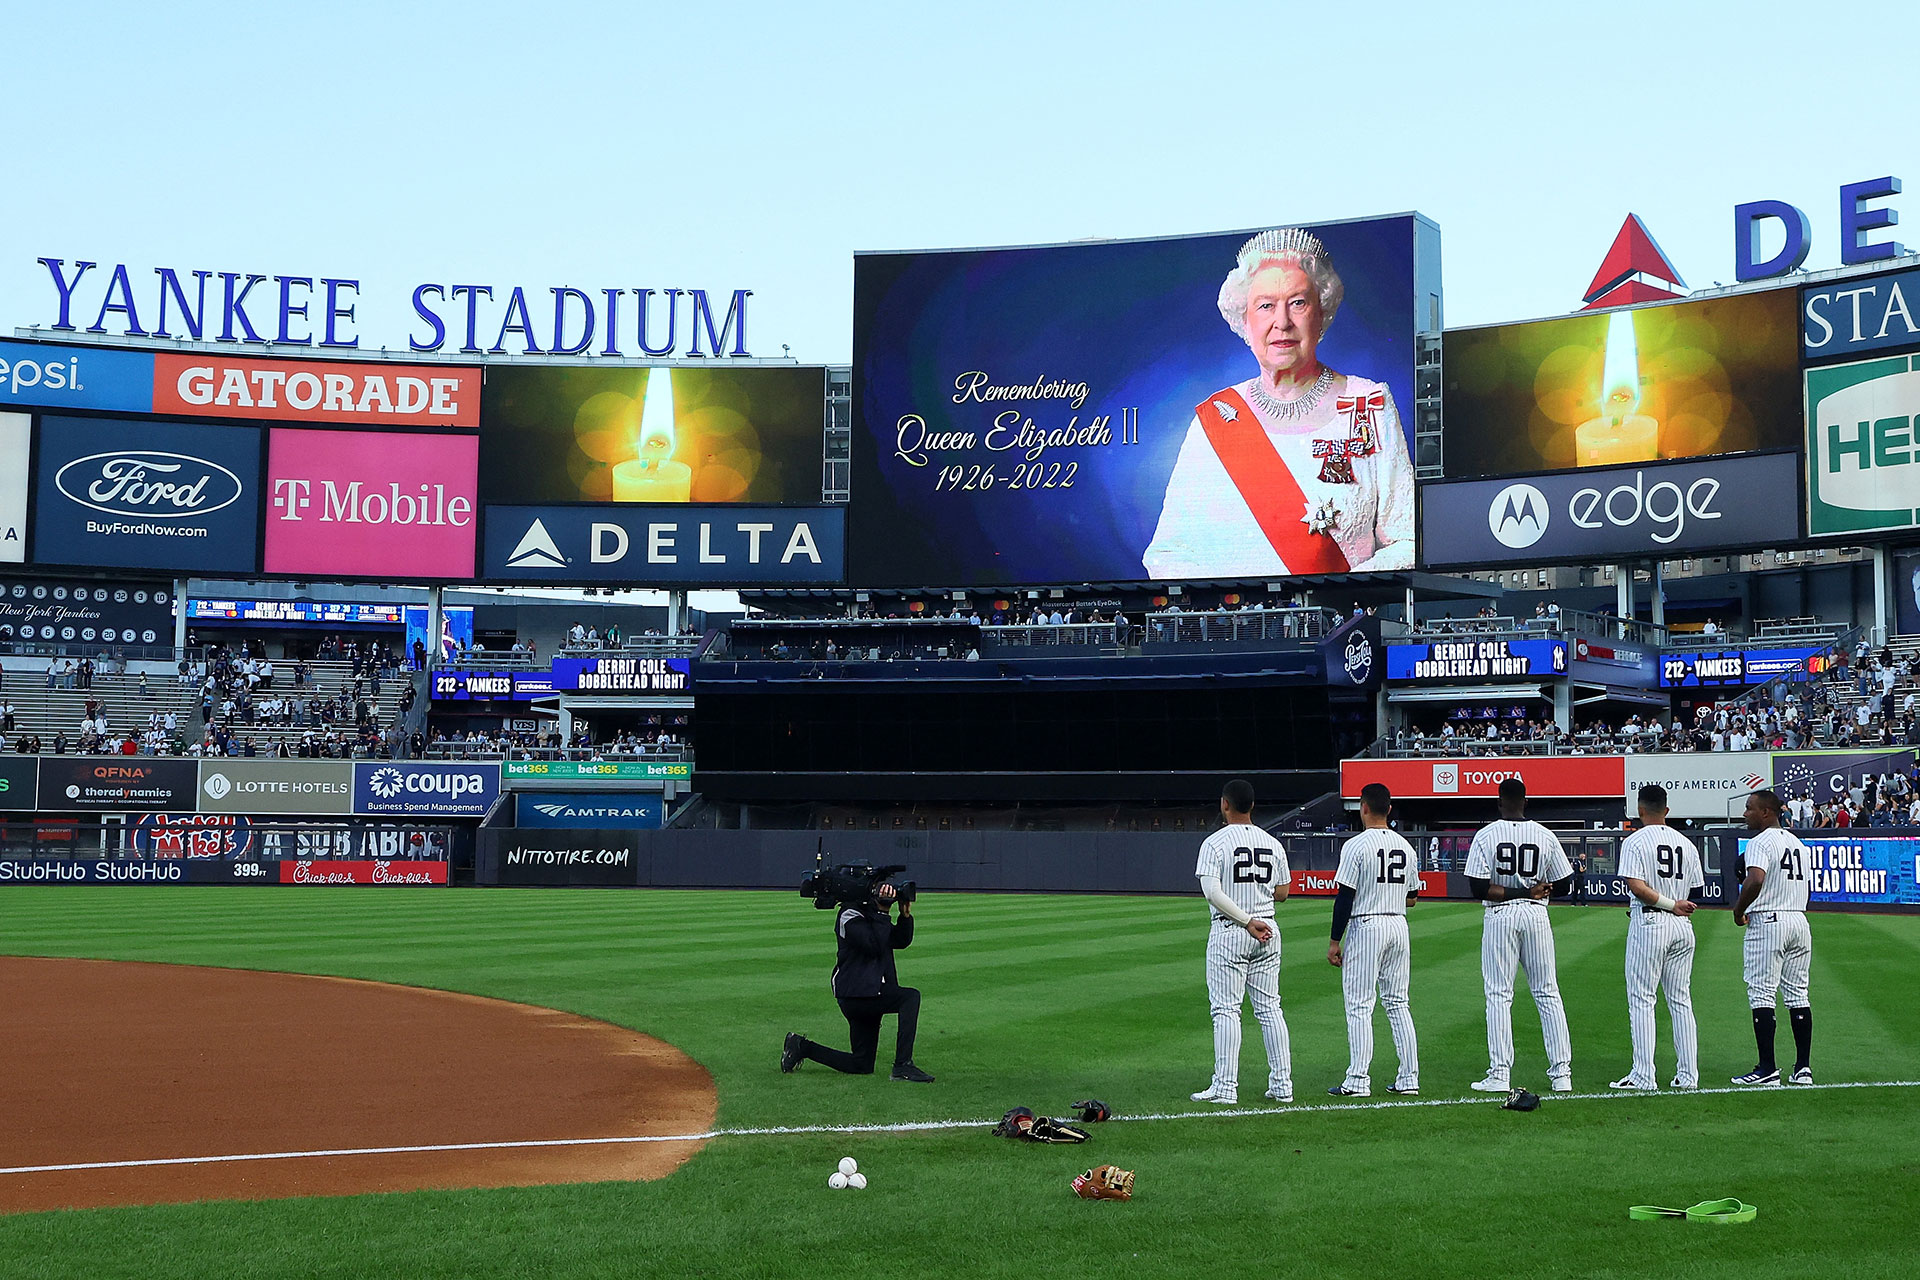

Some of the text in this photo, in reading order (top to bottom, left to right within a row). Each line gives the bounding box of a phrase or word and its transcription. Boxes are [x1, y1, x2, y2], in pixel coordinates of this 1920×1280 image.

[37, 257, 754, 357] YANKEE STADIUM
[177, 367, 459, 415] GATORADE
[952, 371, 1090, 409] Remembering
[894, 407, 1139, 467] Queen Elizabeth II
[89, 458, 210, 508] Ford
[935, 462, 1079, 491] 1926-2022
[320, 480, 471, 526] Mobile
[1569, 471, 1722, 544] edge
[86, 521, 208, 537] BuyFordNow.com
[590, 523, 823, 563] DELTA
[0, 602, 101, 623] New York Yankees
[1434, 641, 1508, 661] GERRIT COLE
[597, 659, 667, 674] GERRIT COLE
[1415, 657, 1529, 678] BOBBLEHEAD NIGHT
[1664, 660, 1685, 679] 212
[1693, 659, 1742, 678] YANKEES
[436, 678, 456, 693] 212
[466, 677, 511, 693] YANKEES
[578, 674, 685, 690] BOBBLEHEAD NIGHT
[514, 721, 535, 729] YES
[93, 767, 145, 778] QFNA
[508, 763, 549, 774] bet365
[577, 764, 618, 774] bet365
[647, 765, 688, 775] bet365
[1463, 771, 1524, 785] TOYOTA
[85, 787, 172, 799] theradynamics
[236, 781, 348, 794] LOTTE HOTELS
[405, 773, 484, 800] coupa
[1665, 780, 1680, 790] OF
[1683, 780, 1737, 790] AMERICA
[368, 802, 483, 812] Business Spend Management
[564, 808, 646, 817] AMTRAK
[507, 846, 629, 868] NITTOTIRE.COM
[1233, 846, 1273, 884] 25
[1376, 848, 1407, 885] 12
[1495, 842, 1540, 878] 90
[1656, 844, 1684, 880] 91
[1780, 847, 1804, 881] 41
[1829, 845, 1863, 869] COLE
[0, 861, 86, 880] StubHub
[94, 862, 182, 880] StubHub
[293, 860, 356, 884] Chick-fil-A
[372, 859, 433, 884] Chick-fil-A
[1845, 869, 1887, 894] NIGHT
